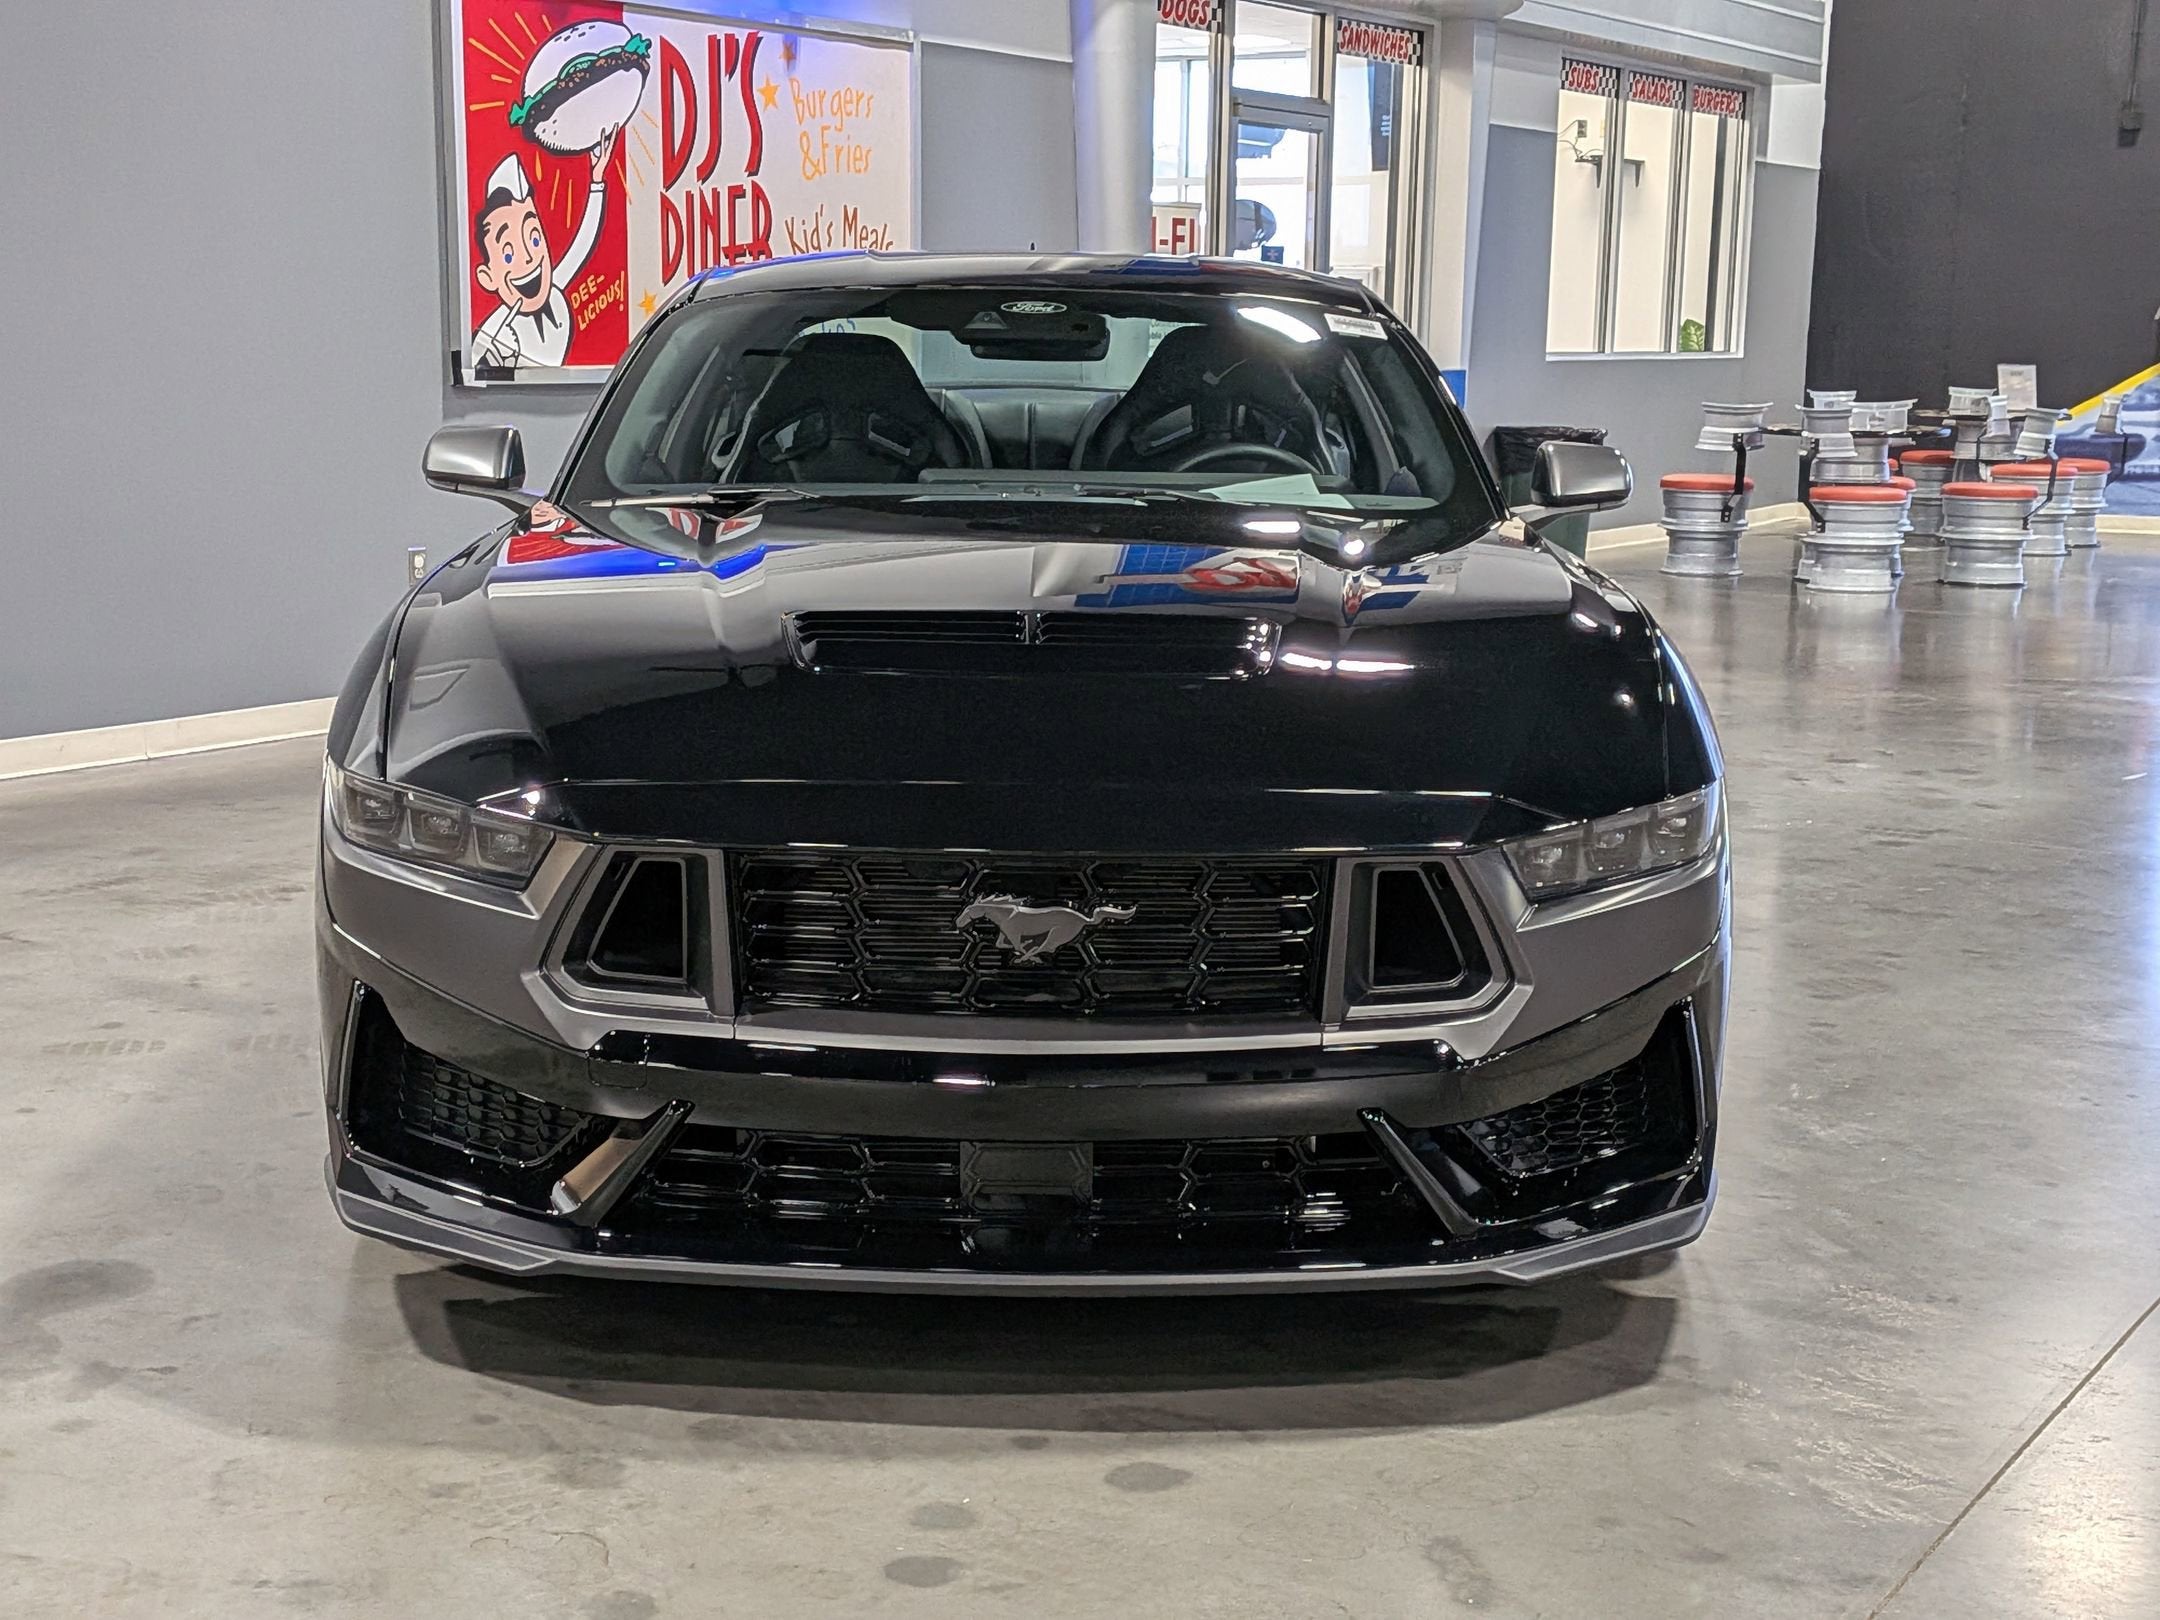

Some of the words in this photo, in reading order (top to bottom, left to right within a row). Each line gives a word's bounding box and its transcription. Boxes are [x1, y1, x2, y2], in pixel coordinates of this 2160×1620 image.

[1161, 0, 1211, 26] DOGS
[1340, 25, 1411, 60] SANDWICHES
[1568, 66, 1600, 91] SUBS
[1632, 78, 1674, 104] SALADS
[659, 31, 764, 192] DJ'S
[789, 77, 874, 132] Burgers
[1693, 88, 1739, 114] BURGERS
[659, 180, 774, 288] DINER
[784, 203, 834, 255] Kid's
[570, 274, 606, 310] DEE-
[577, 270, 625, 331] LICIOUS!
[1012, 302, 1056, 313] Ford
